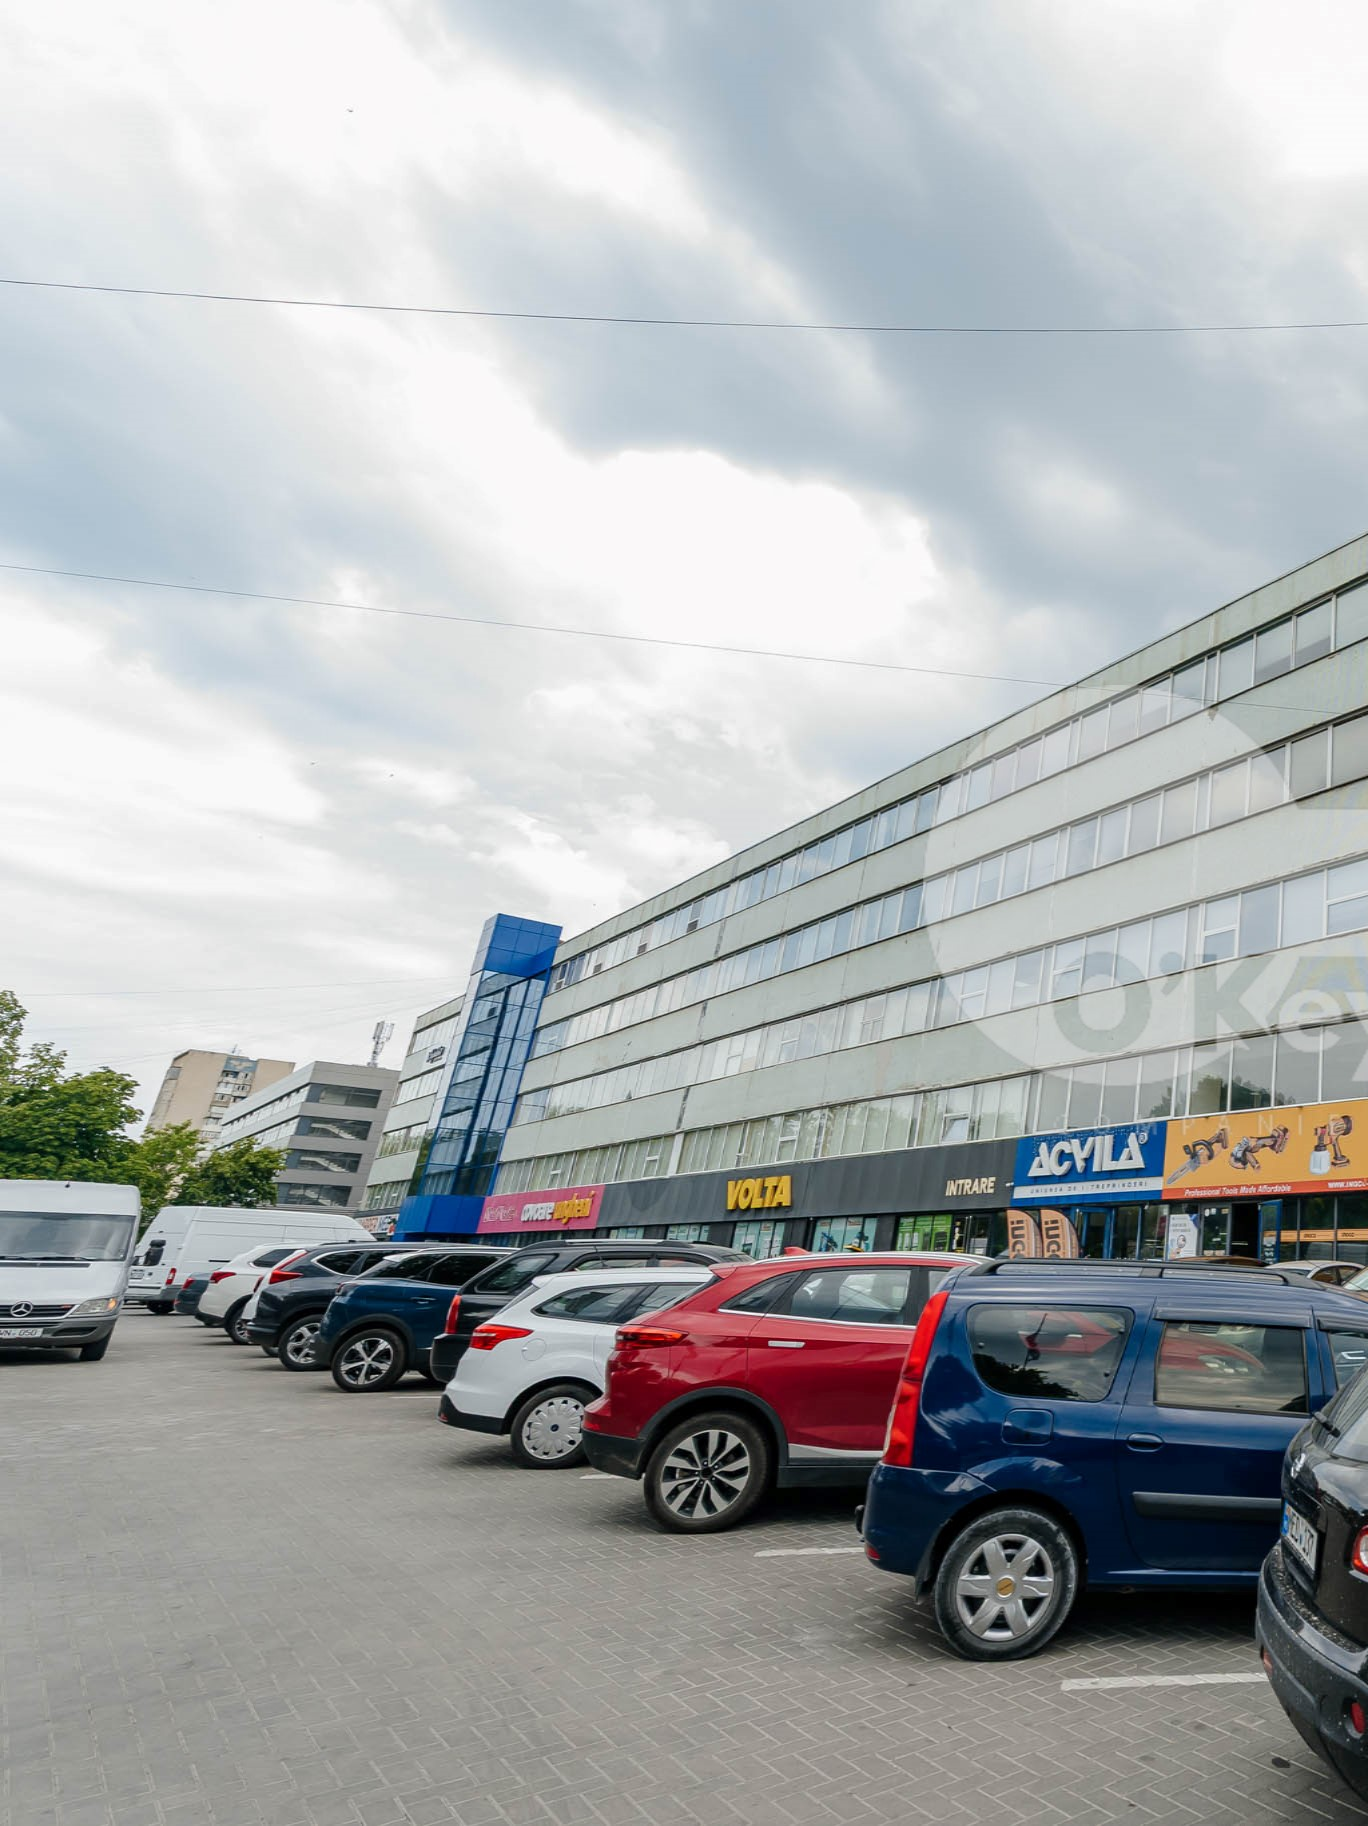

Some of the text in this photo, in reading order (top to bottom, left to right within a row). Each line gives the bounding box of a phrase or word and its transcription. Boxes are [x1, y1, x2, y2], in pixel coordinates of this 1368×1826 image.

[1027, 1132, 1146, 1177] ACVILA
[726, 1175, 792, 1210] VOLTA
[945, 1176, 996, 1198] INTRARE
